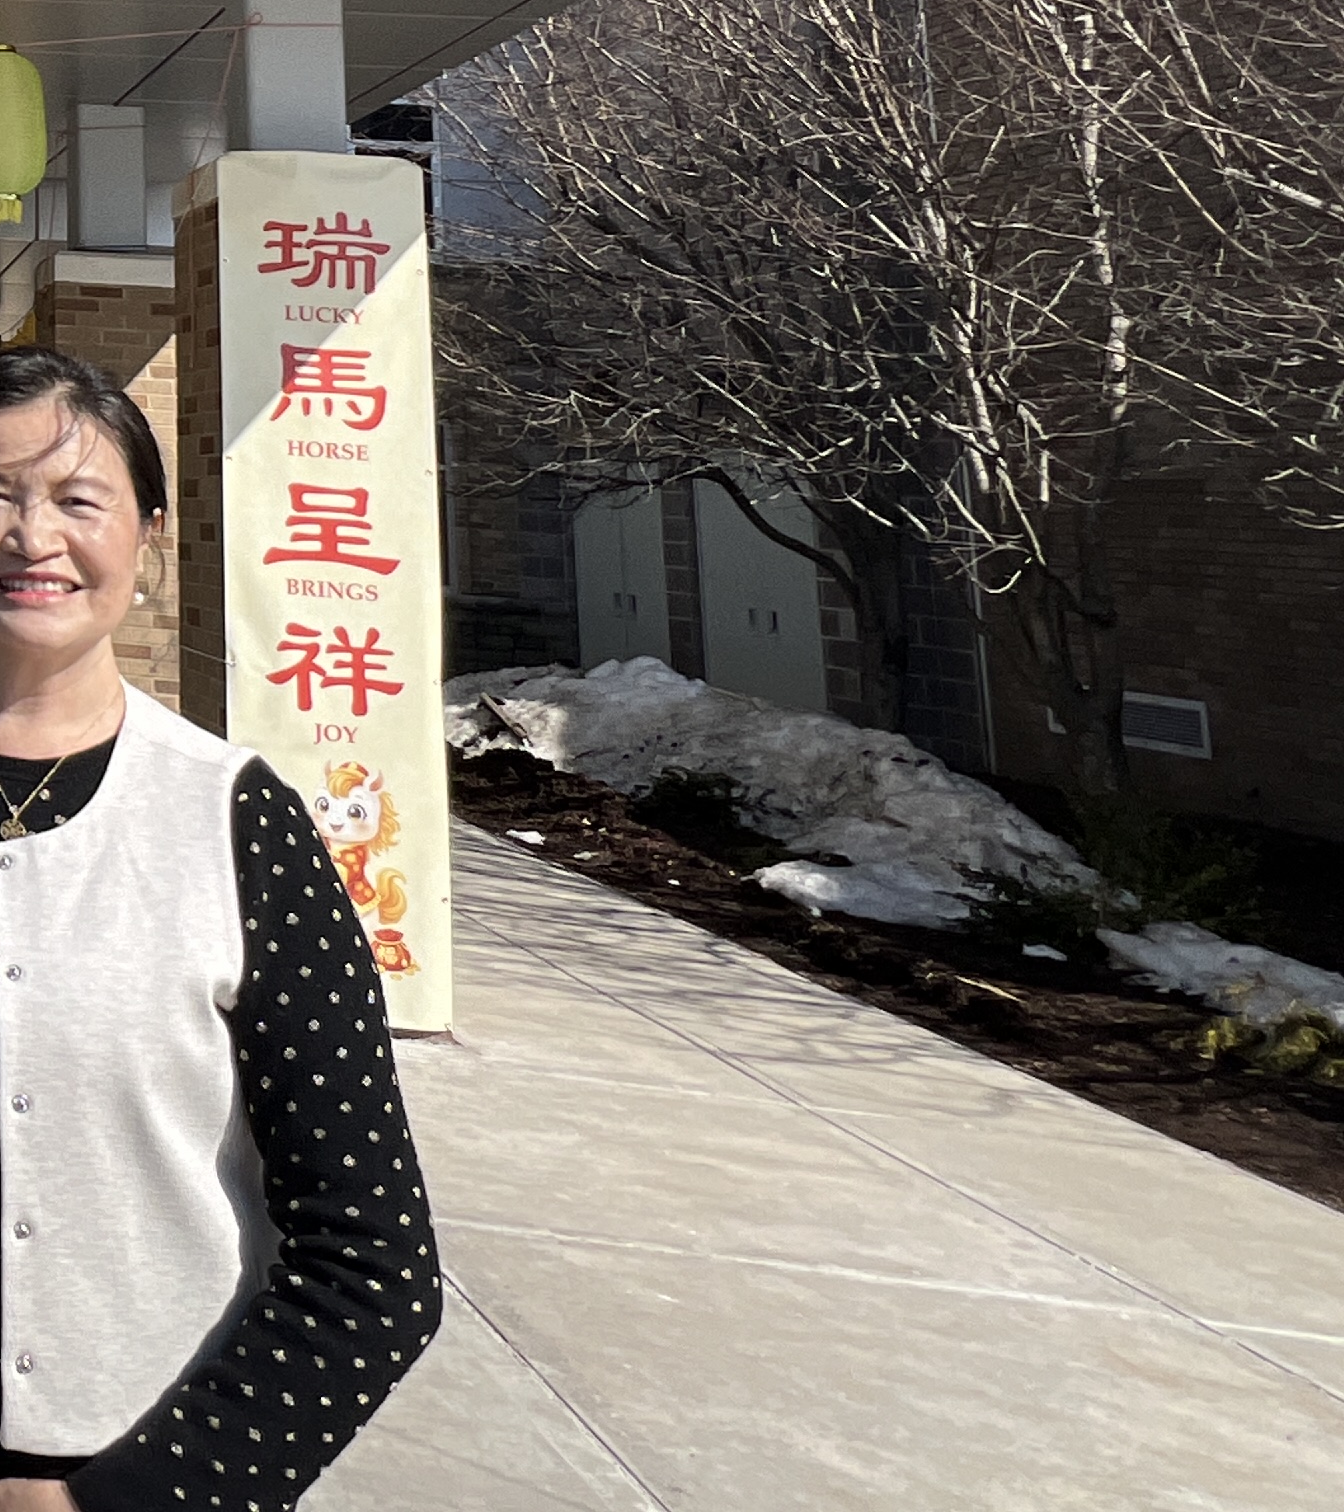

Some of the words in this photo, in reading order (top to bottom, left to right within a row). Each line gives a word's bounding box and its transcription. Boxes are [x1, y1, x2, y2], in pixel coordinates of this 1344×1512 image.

[284, 304, 364, 325] LUCKY
[287, 440, 370, 462] HORSE
[286, 578, 379, 602] BRINGS
[313, 722, 358, 745] JOY
